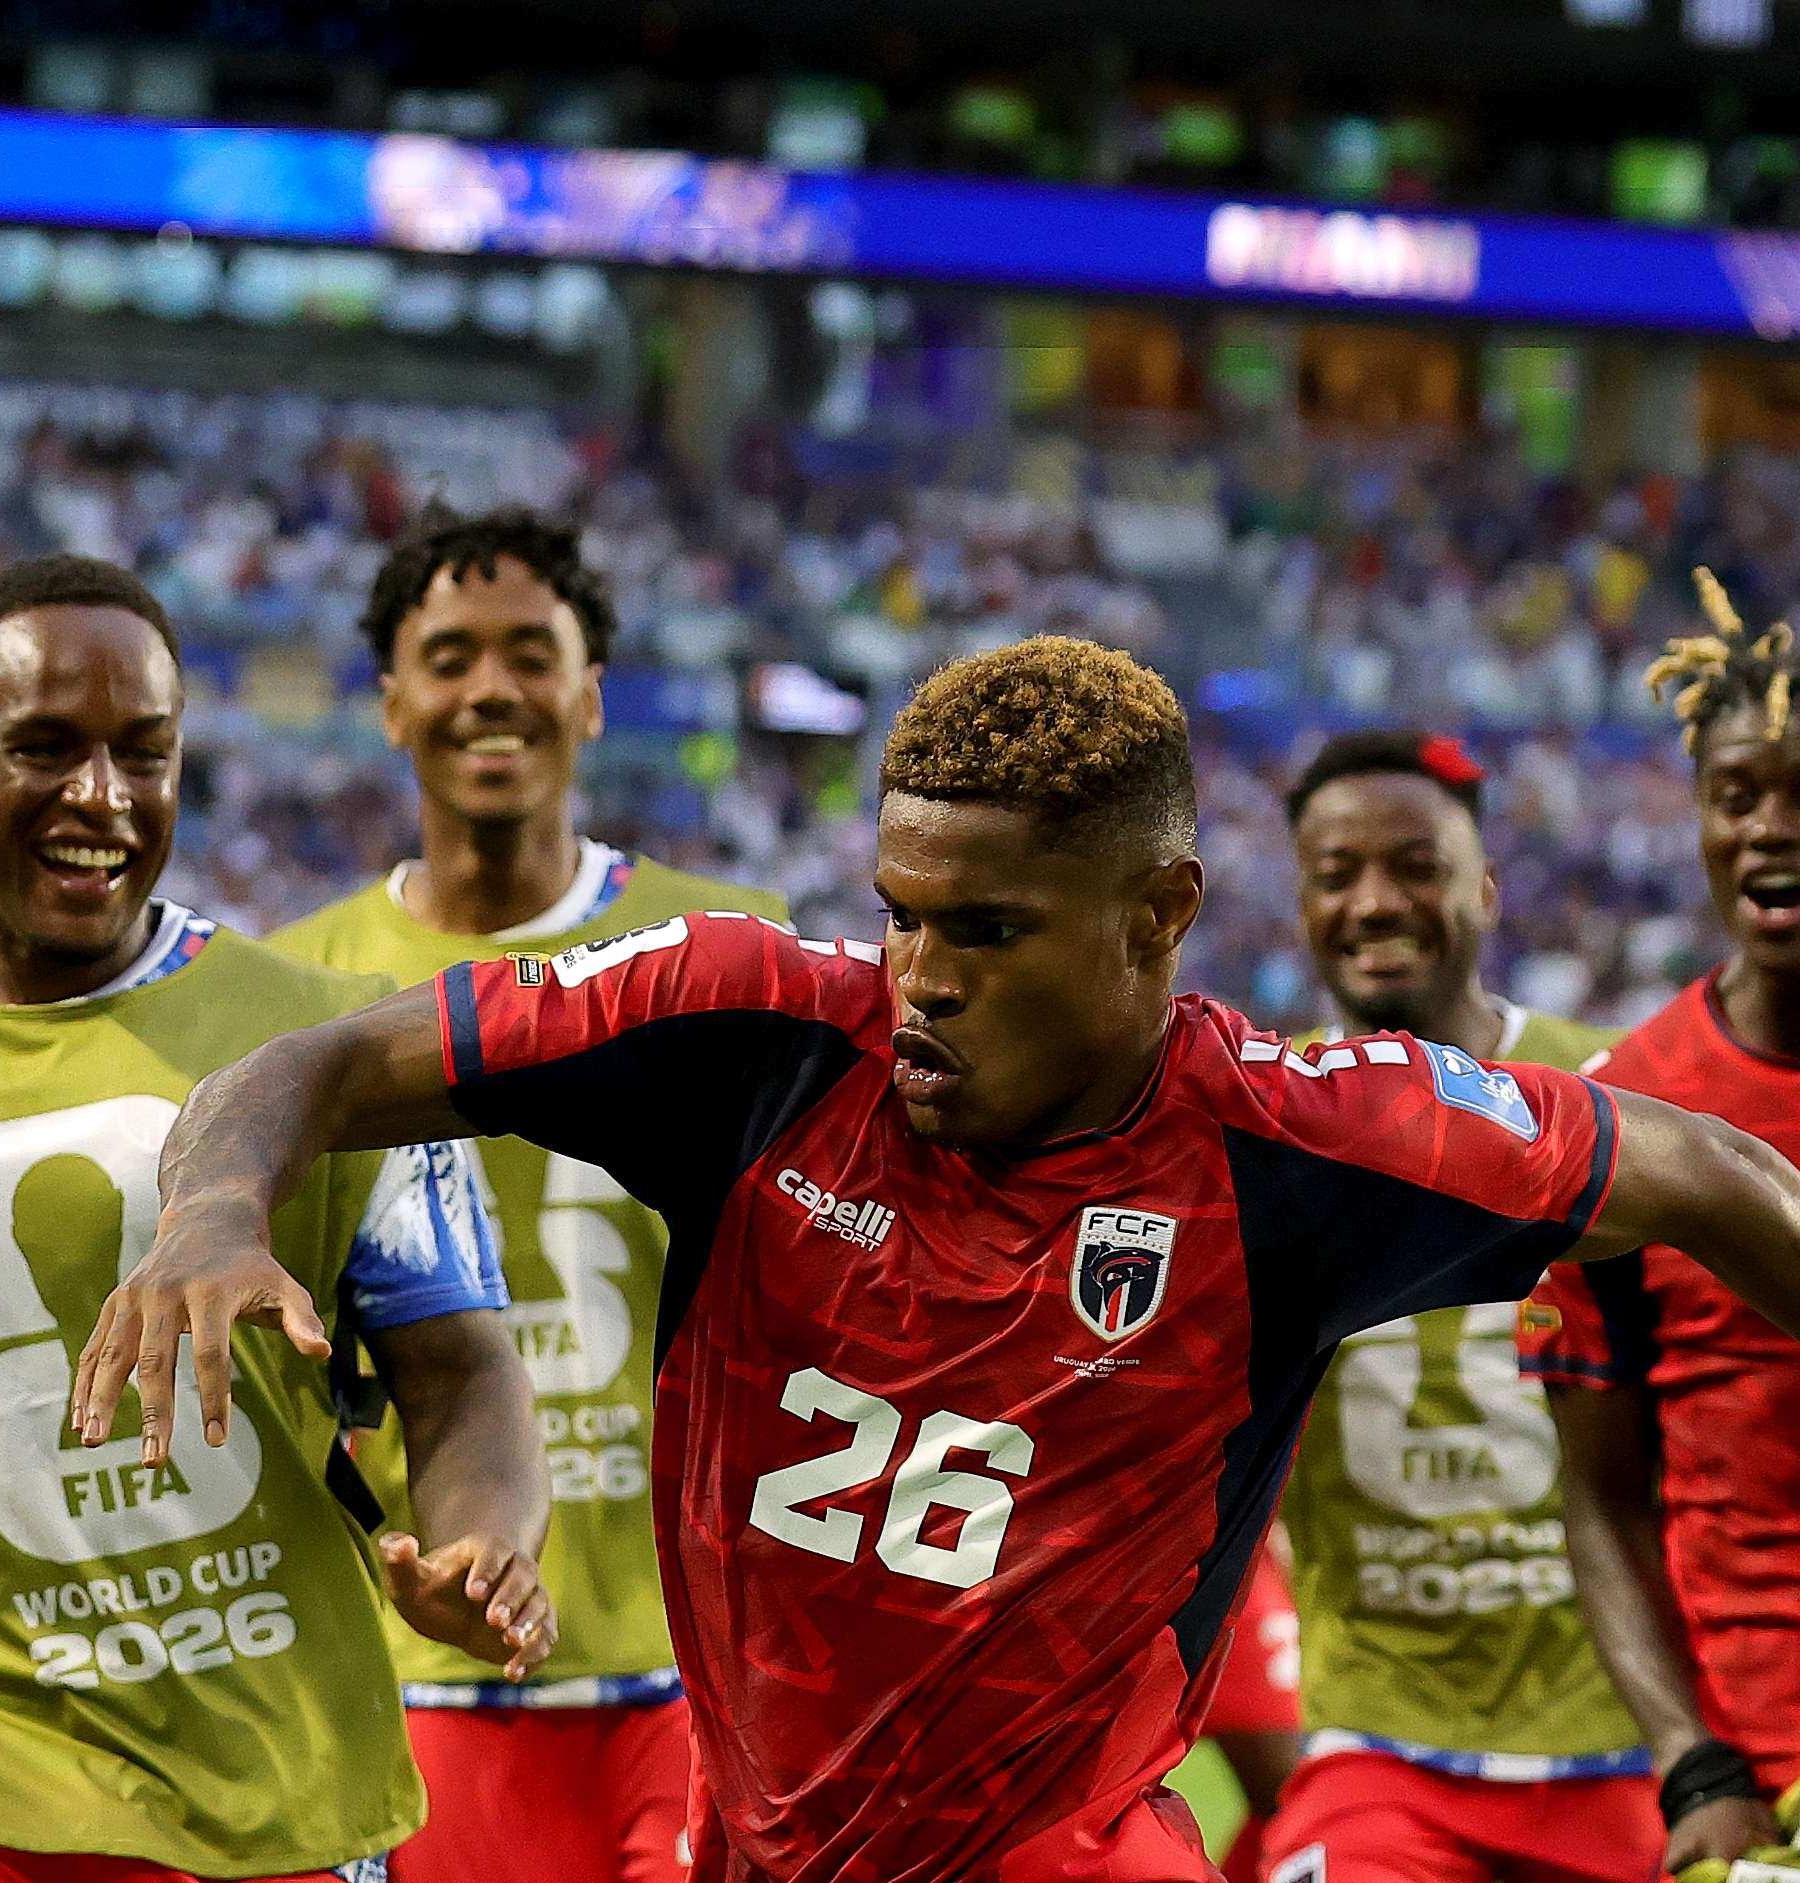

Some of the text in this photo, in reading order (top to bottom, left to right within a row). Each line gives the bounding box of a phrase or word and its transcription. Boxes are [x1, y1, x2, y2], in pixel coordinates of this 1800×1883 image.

[776, 1168, 897, 1242] capelli
[813, 1216, 881, 1252] SPORT
[1088, 1213, 1169, 1237] FCF
[61, 1457, 192, 1517] FIFA
[749, 1367, 1035, 1589] 26
[13, 1541, 283, 1629] WORLD CUP
[29, 1591, 298, 1689] 2026
